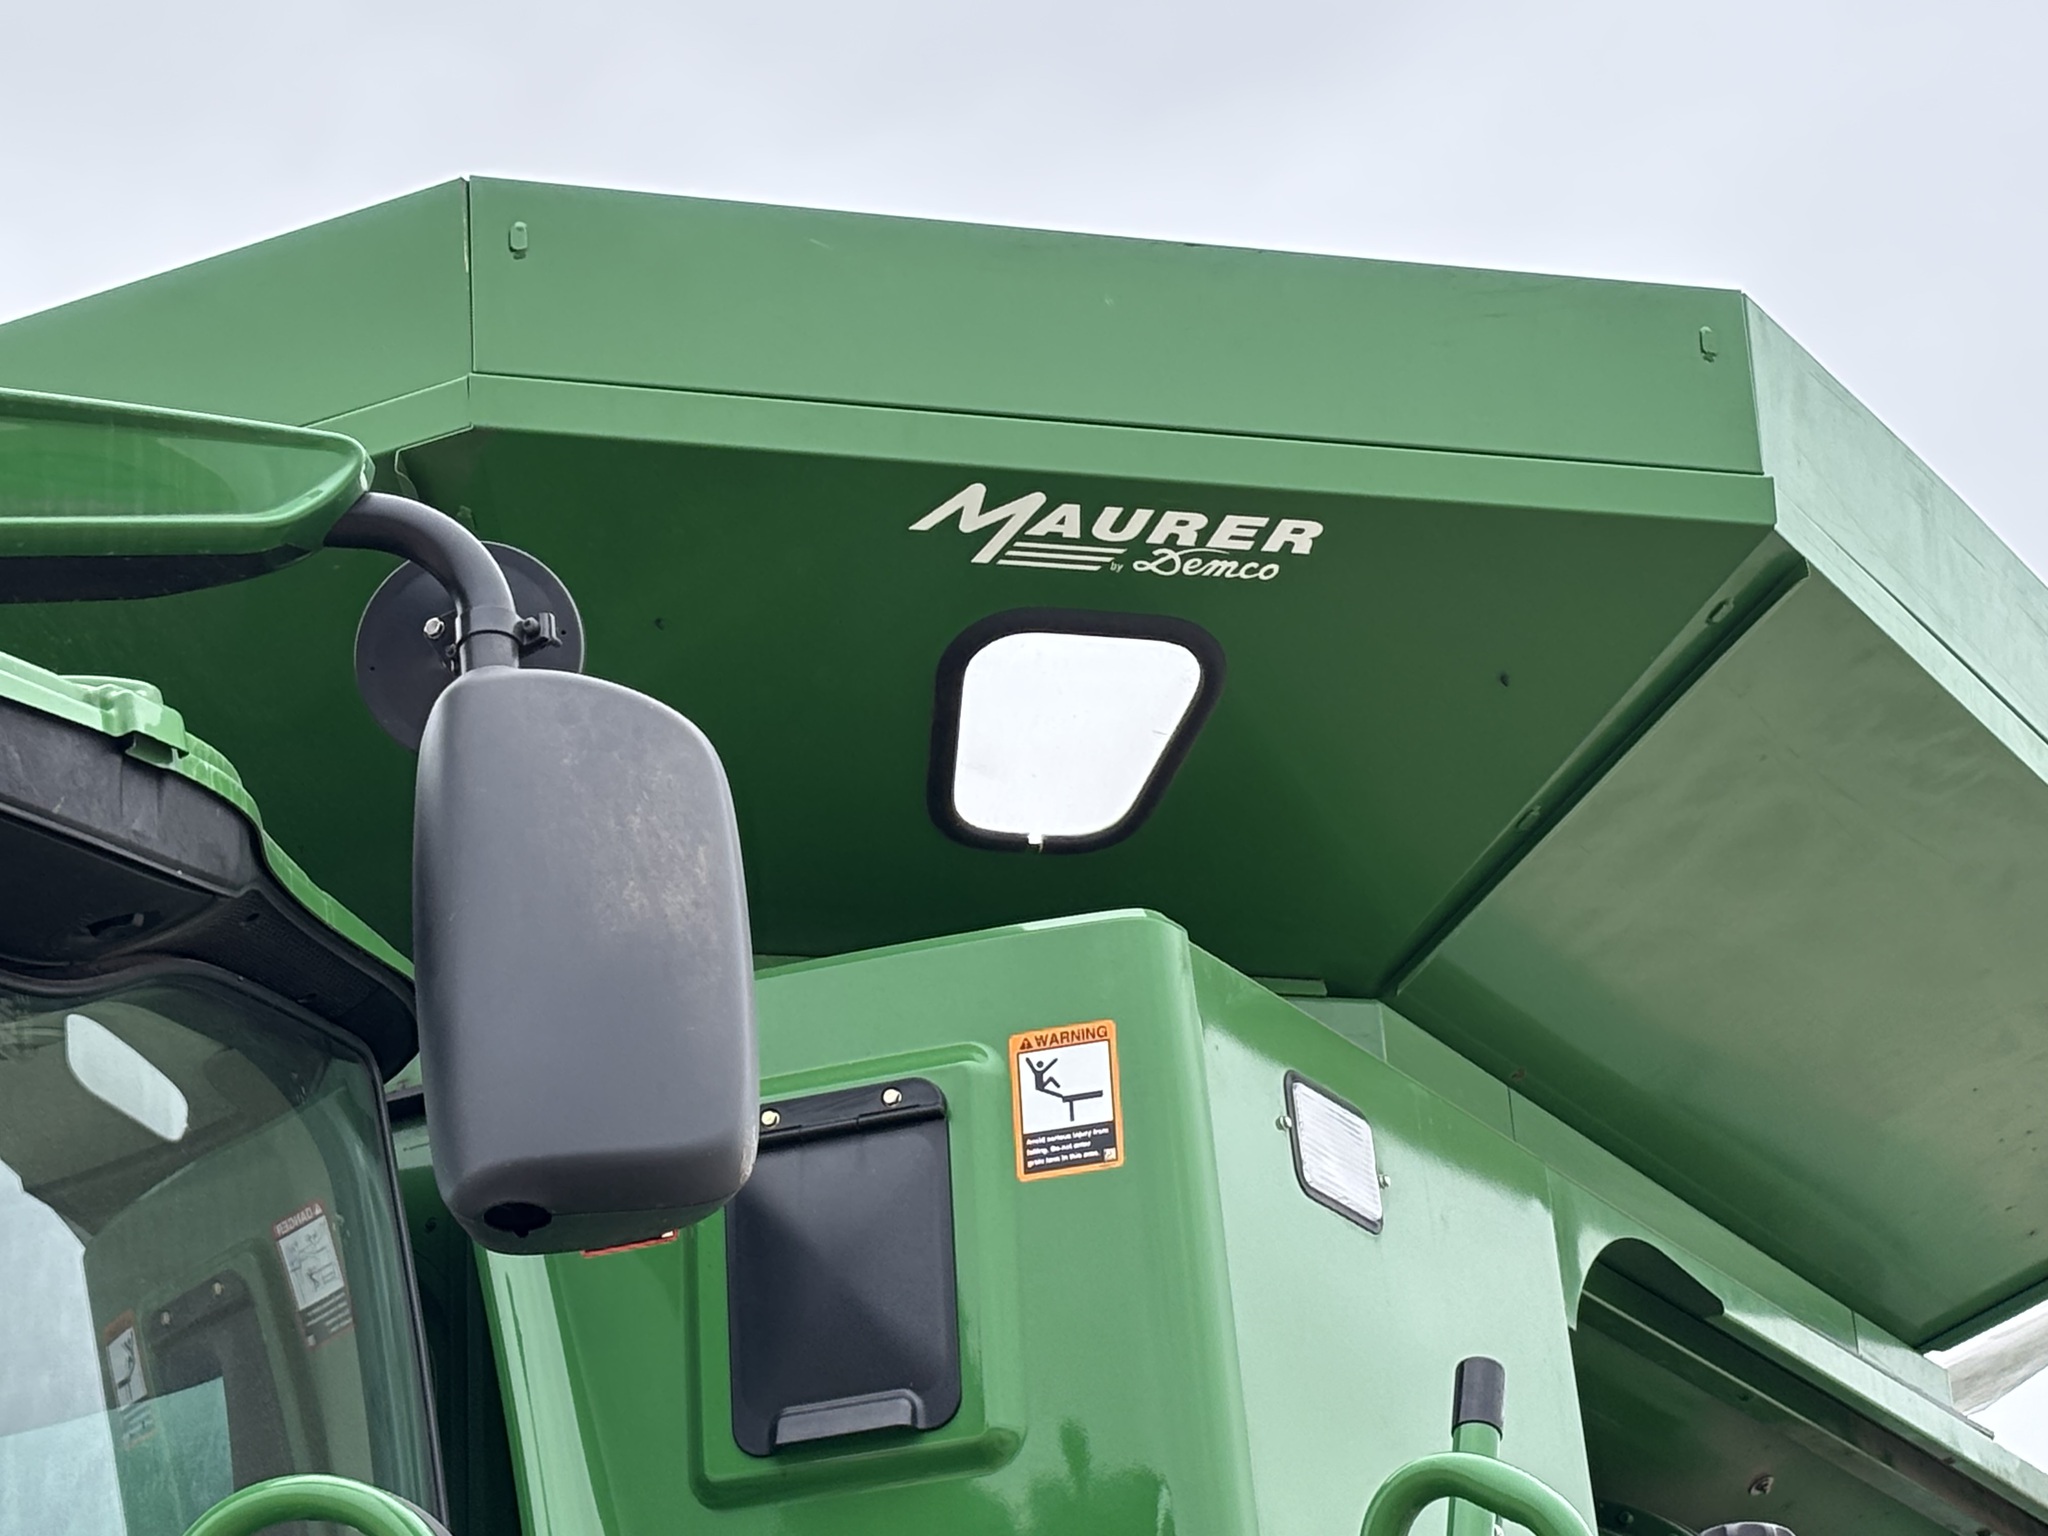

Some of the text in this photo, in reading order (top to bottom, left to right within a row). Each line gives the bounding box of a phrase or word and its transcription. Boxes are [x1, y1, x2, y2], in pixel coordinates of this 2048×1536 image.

[908, 483, 1323, 564] MAURER
[1110, 547, 1279, 581] by Demco
[1034, 1025, 1108, 1047] WARNING
[1026, 1127, 1109, 1145] Avoid serious injury from
